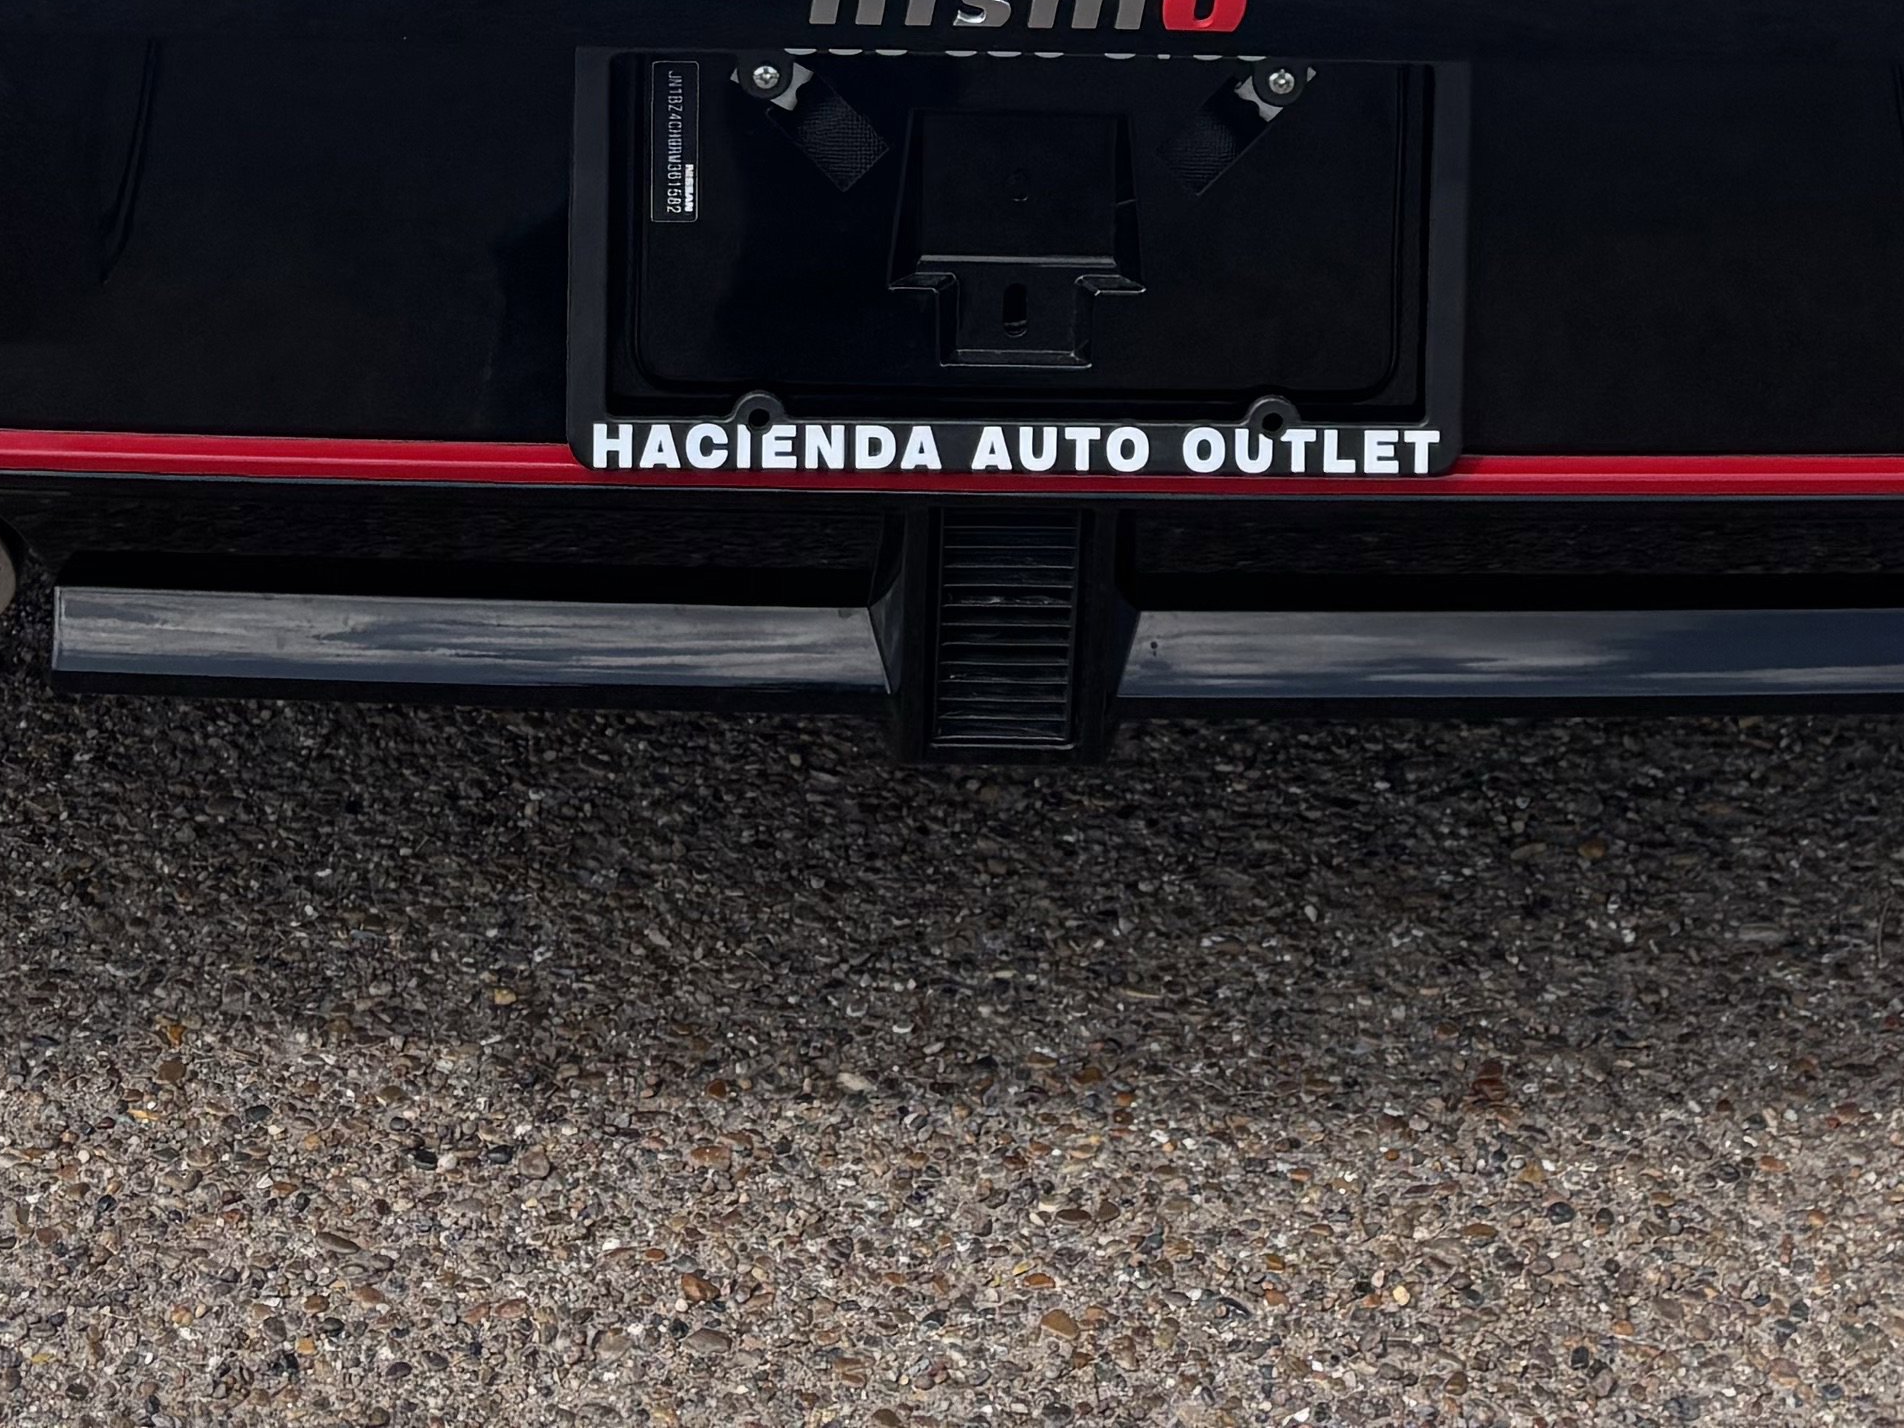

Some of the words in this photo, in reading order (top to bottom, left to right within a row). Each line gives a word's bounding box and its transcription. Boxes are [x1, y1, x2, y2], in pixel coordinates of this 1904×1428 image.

[592, 423, 943, 470] HACIENDA
[970, 425, 1151, 472] AUTO
[1181, 426, 1441, 475] OUTLET
